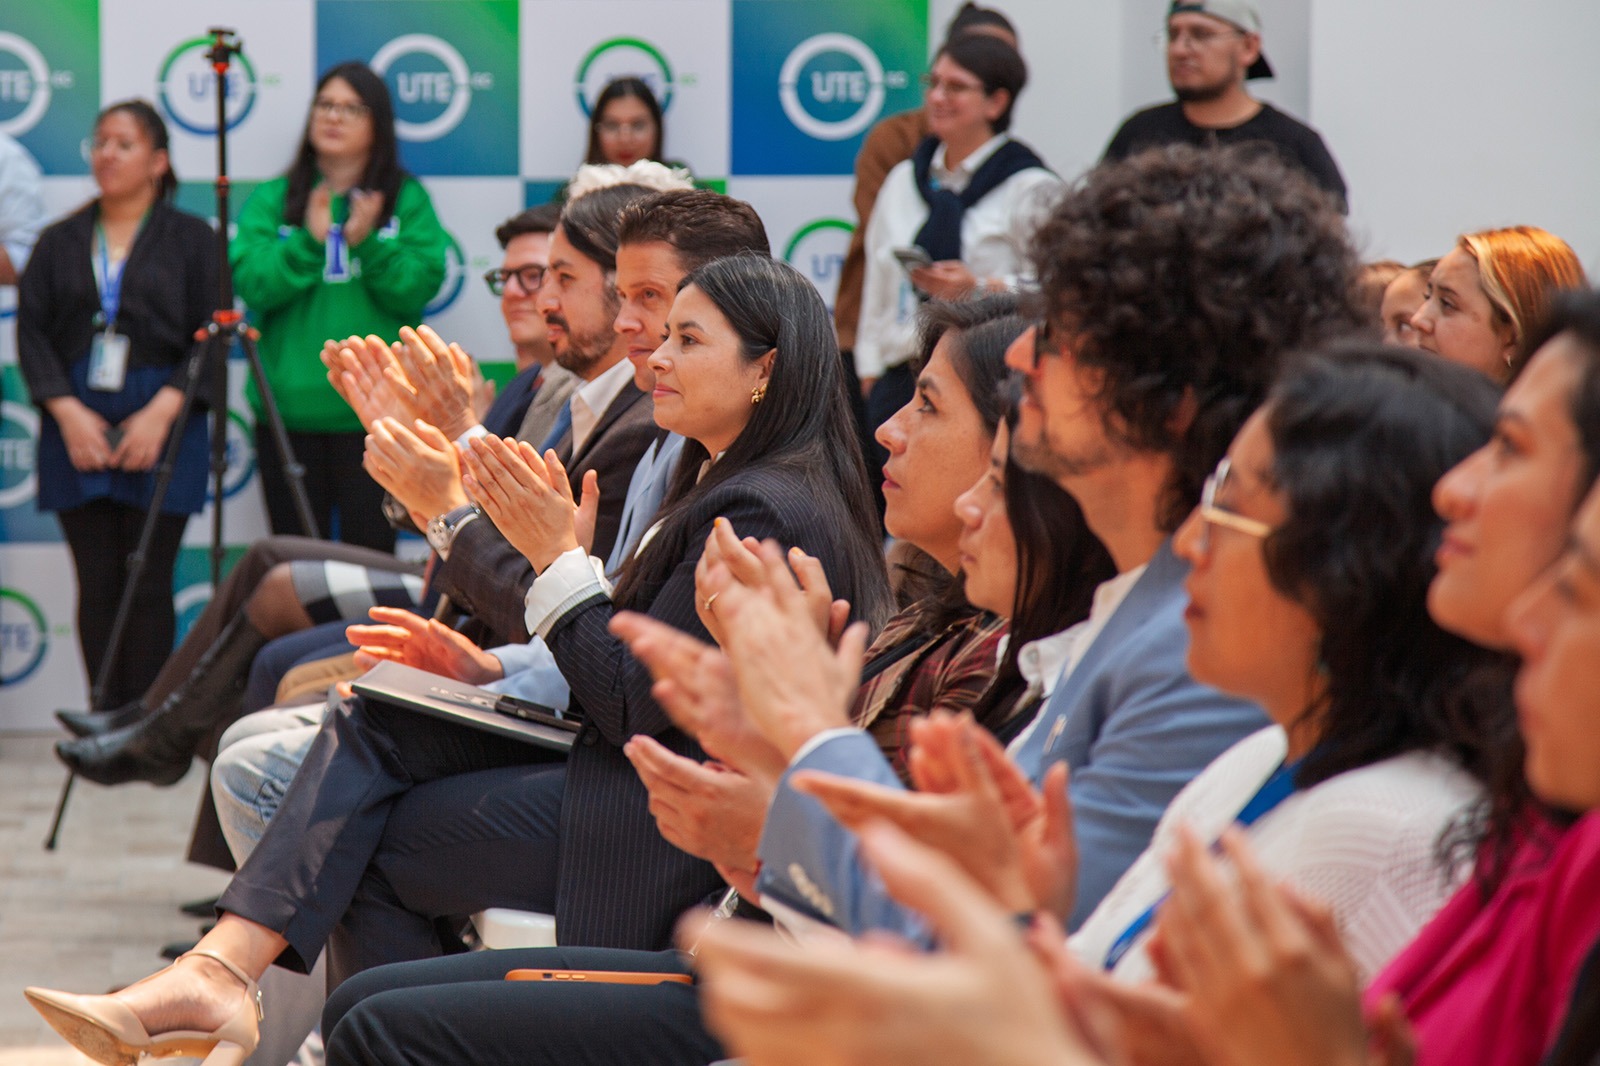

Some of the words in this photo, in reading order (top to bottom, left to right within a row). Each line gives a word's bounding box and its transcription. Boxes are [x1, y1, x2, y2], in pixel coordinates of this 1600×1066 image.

[187, 73, 240, 102] UE
[397, 71, 450, 103] UTE
[810, 70, 867, 103] UTE
[810, 254, 848, 282] UT
